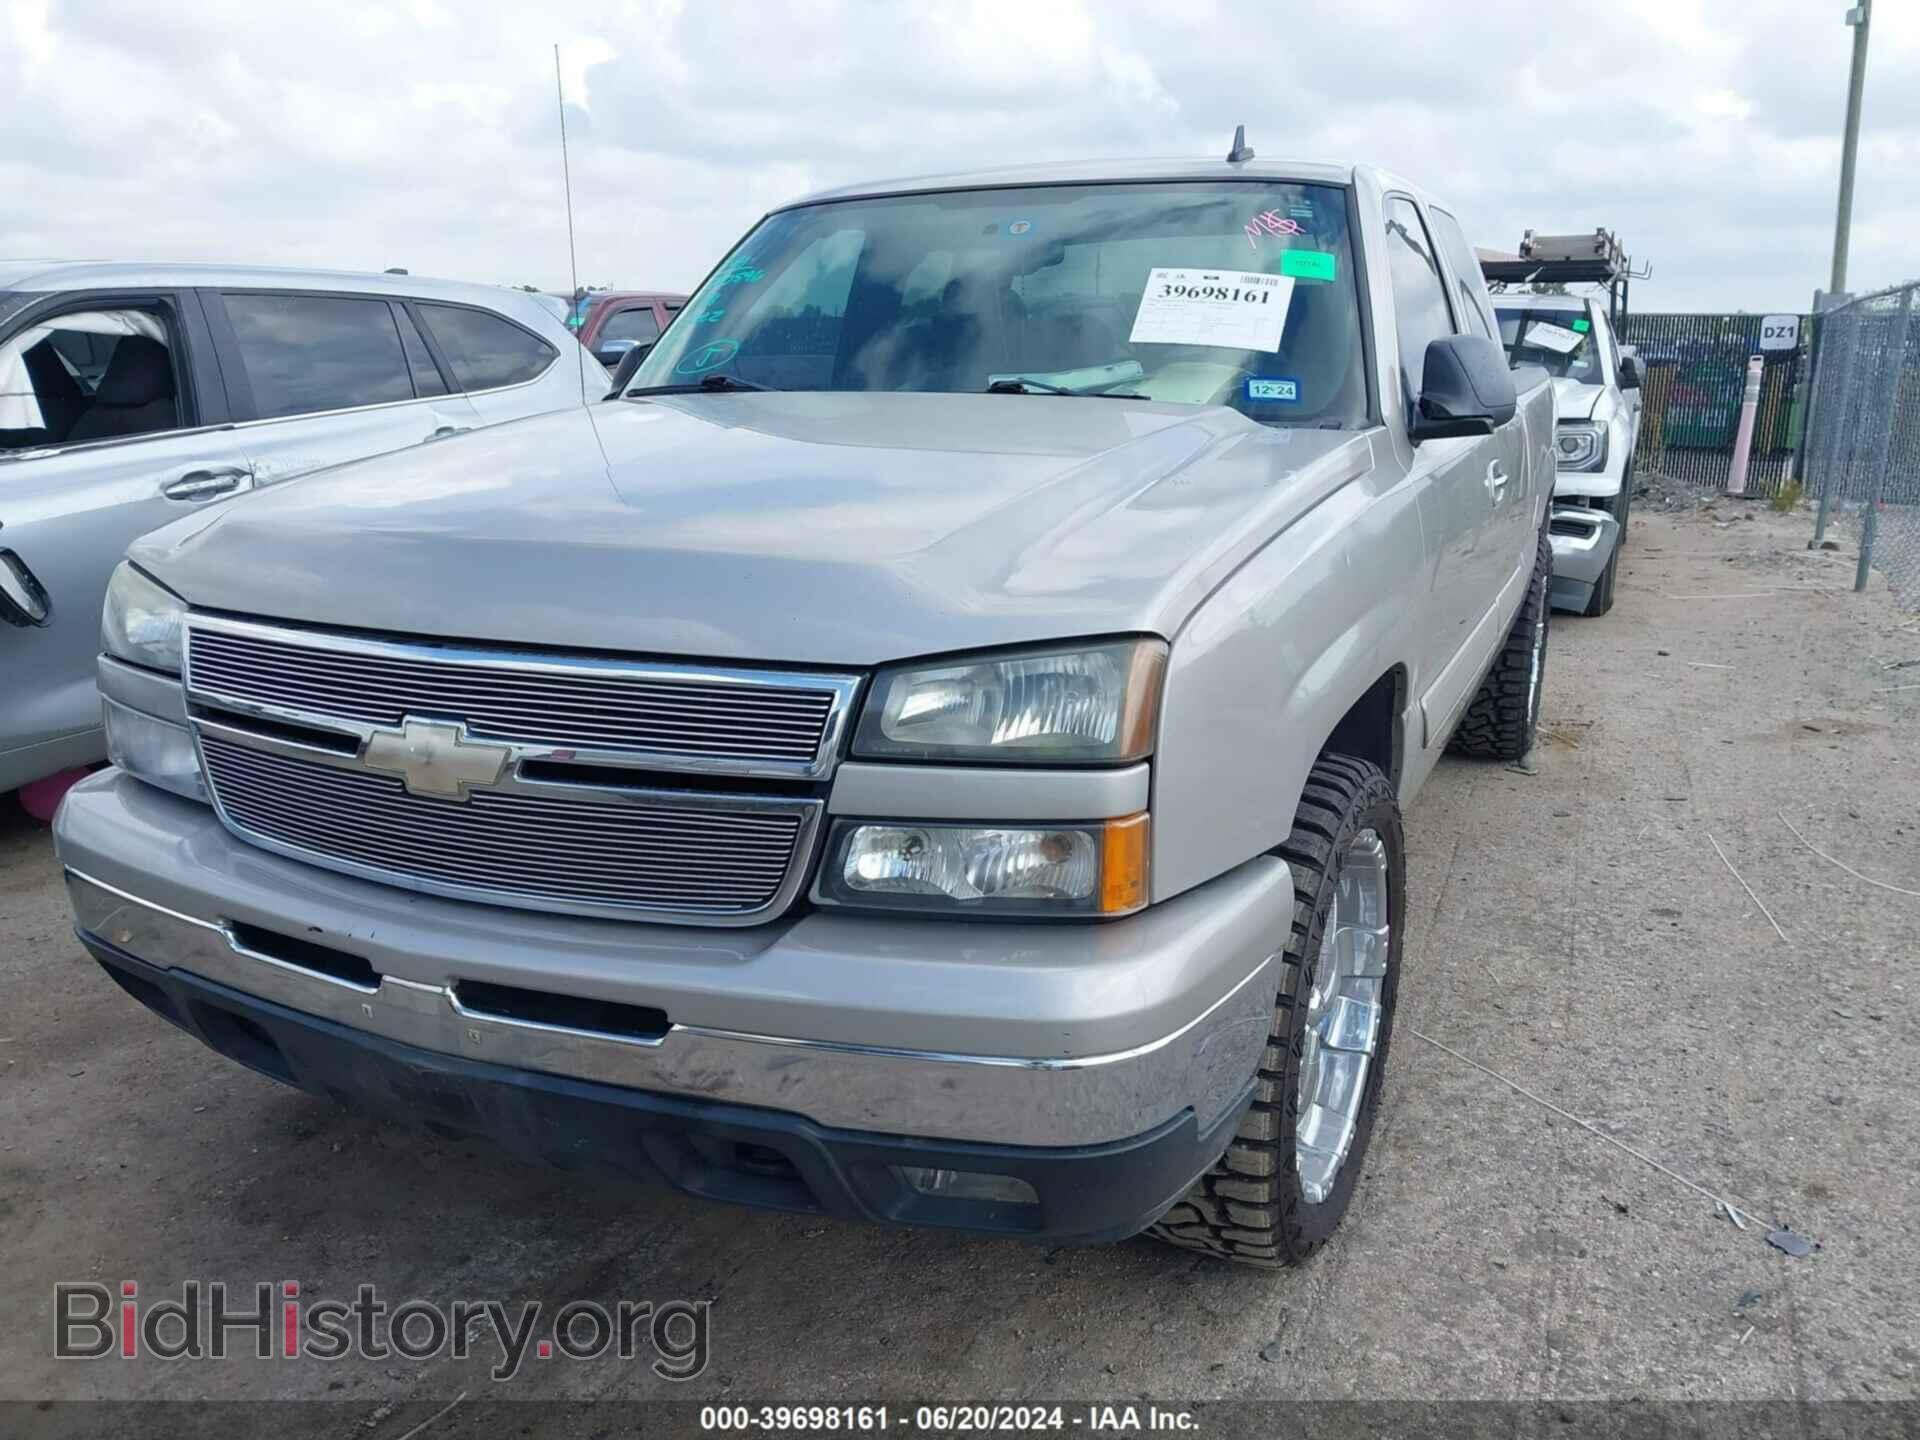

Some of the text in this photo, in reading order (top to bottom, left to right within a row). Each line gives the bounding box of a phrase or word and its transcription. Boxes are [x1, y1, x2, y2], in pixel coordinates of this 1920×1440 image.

[1157, 284, 1270, 304] 39698161
[1764, 326, 1794, 338] DZ1
[1278, 386, 1293, 395] 24
